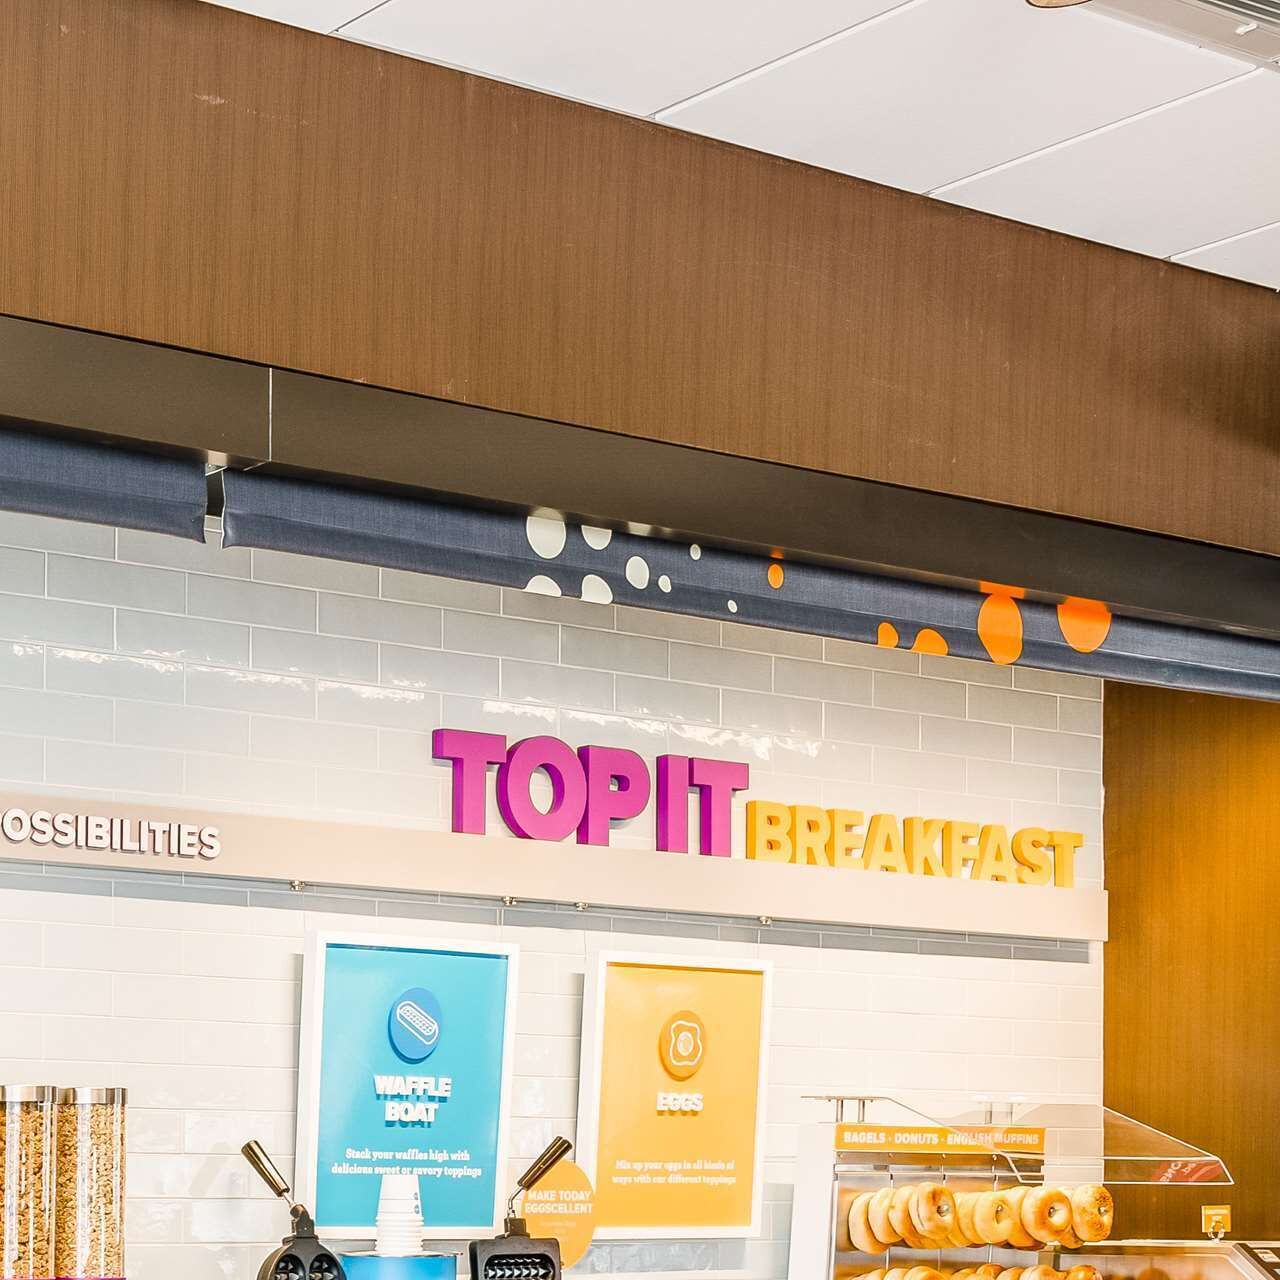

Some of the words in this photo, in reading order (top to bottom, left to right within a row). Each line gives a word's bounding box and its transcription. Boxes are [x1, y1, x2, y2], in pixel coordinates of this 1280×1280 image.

[432, 728, 651, 846] TOP
[656, 754, 749, 857] IT
[746, 800, 1084, 888] BREAKFAST
[374, 1074, 452, 1099] WAFFLE
[656, 1092, 704, 1112] EGGS
[385, 1102, 439, 1123] BOAT
[843, 1132, 886, 1144] BAGELS
[894, 1132, 939, 1145] DONUTS
[946, 1133, 991, 1146] ENGLISH
[993, 1132, 1039, 1145] MUFFINS
[345, 1148, 371, 1159] Stack
[372, 1150, 394, 1161] your
[395, 1149, 427, 1160] waffles
[429, 1150, 449, 1162] high
[450, 1150, 470, 1161] with
[331, 1163, 373, 1174] delicious
[374, 1165, 400, 1175] sweet
[401, 1166, 411, 1175] or
[413, 1166, 442, 1178] savory
[444, 1166, 482, 1178] toppings
[528, 1190, 557, 1201] MAKE
[558, 1190, 591, 1201] TODAY
[525, 1203, 592, 1214] EGGSCELLENT
